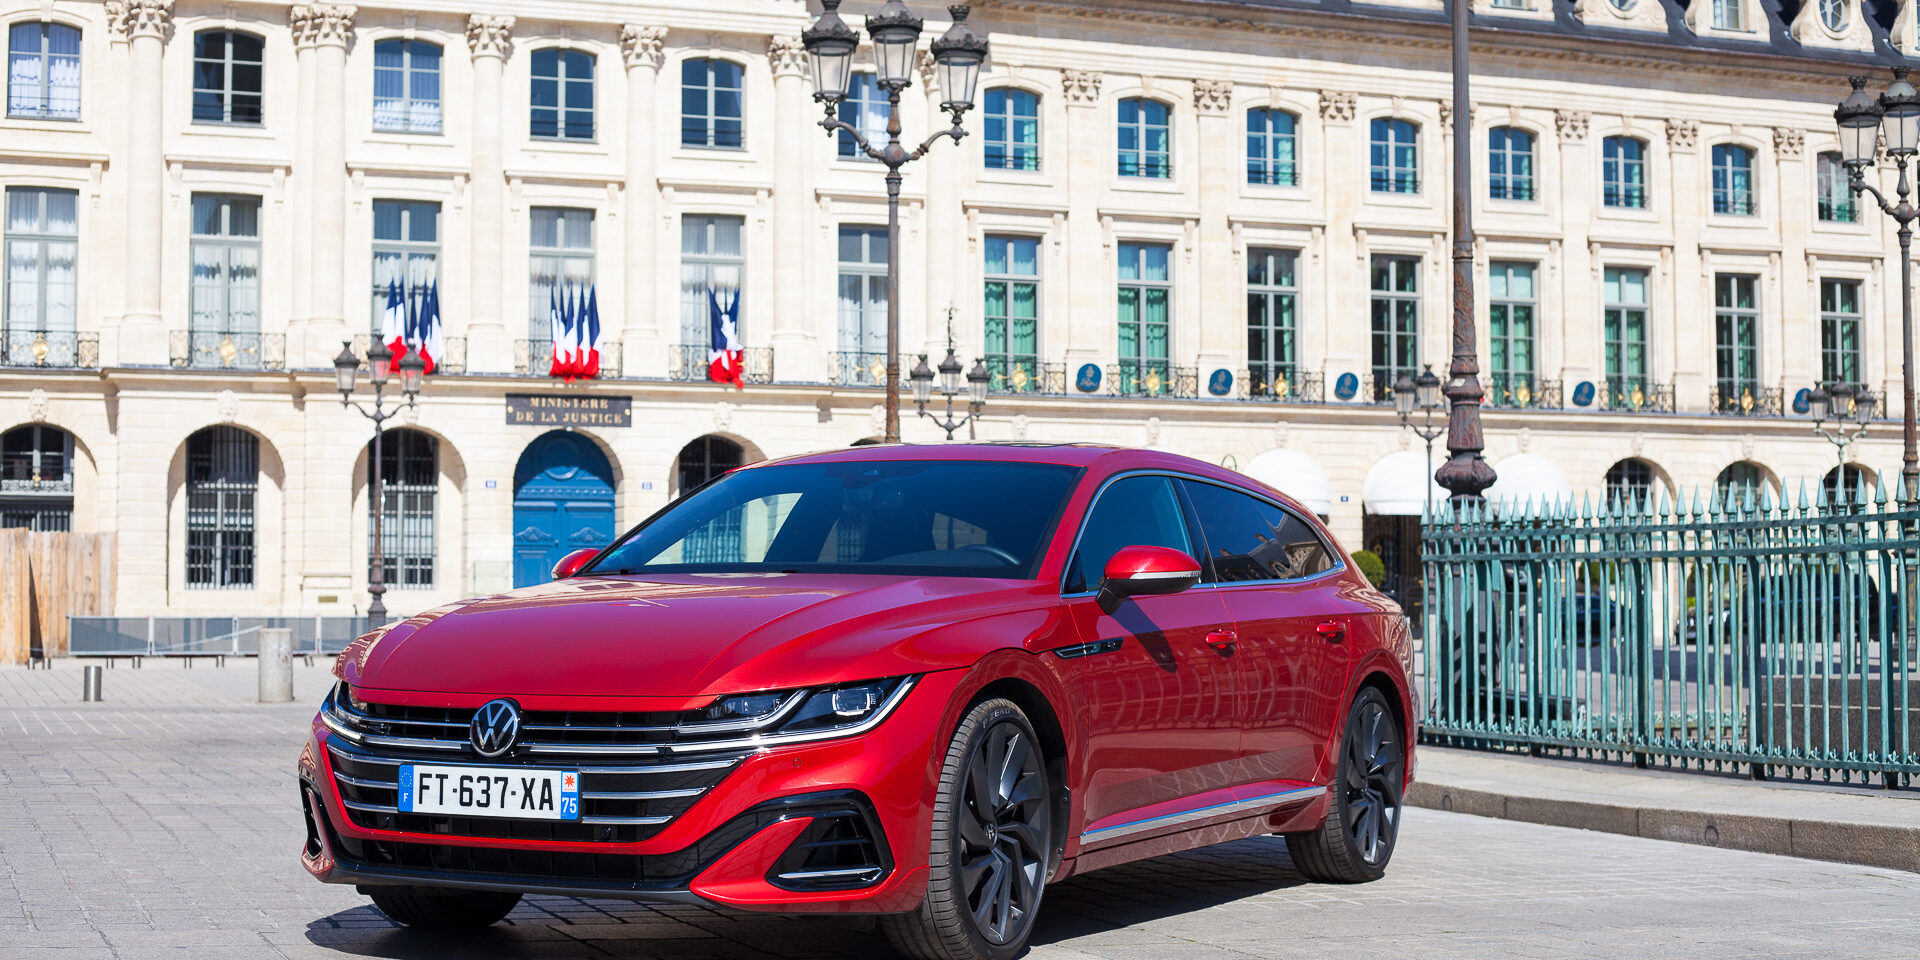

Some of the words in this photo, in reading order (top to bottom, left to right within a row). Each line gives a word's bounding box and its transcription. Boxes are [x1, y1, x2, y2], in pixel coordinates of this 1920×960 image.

[516, 411, 534, 422] DE
[541, 412, 557, 423] LA
[562, 412, 622, 424] JUSTICE
[403, 793, 409, 802] F
[418, 773, 554, 811] FT-637-XA
[561, 797, 577, 814] 75
